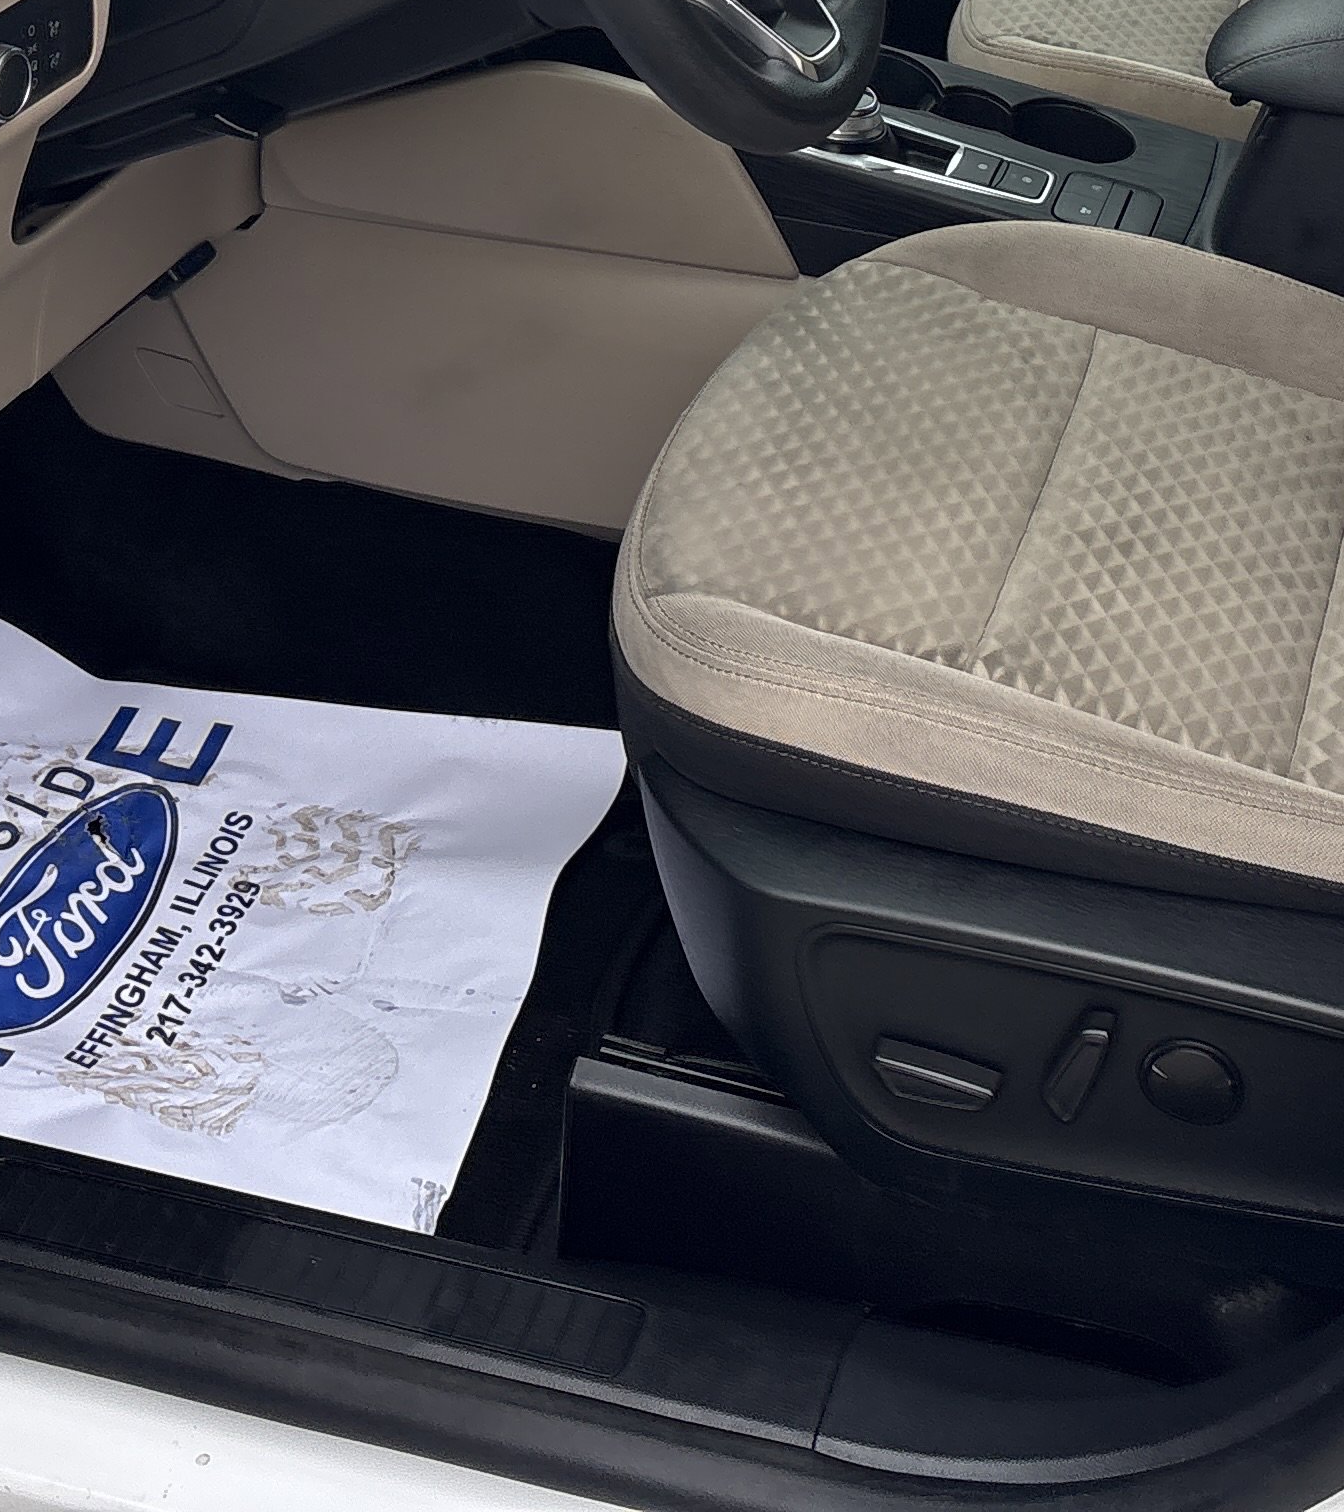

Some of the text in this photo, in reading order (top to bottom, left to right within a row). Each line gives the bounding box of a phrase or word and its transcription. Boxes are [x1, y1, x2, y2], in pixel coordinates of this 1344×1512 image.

[64, 810, 253, 1069] EFFINGHAM, ILLINOIS
[146, 880, 261, 1048] 217-342-3929
